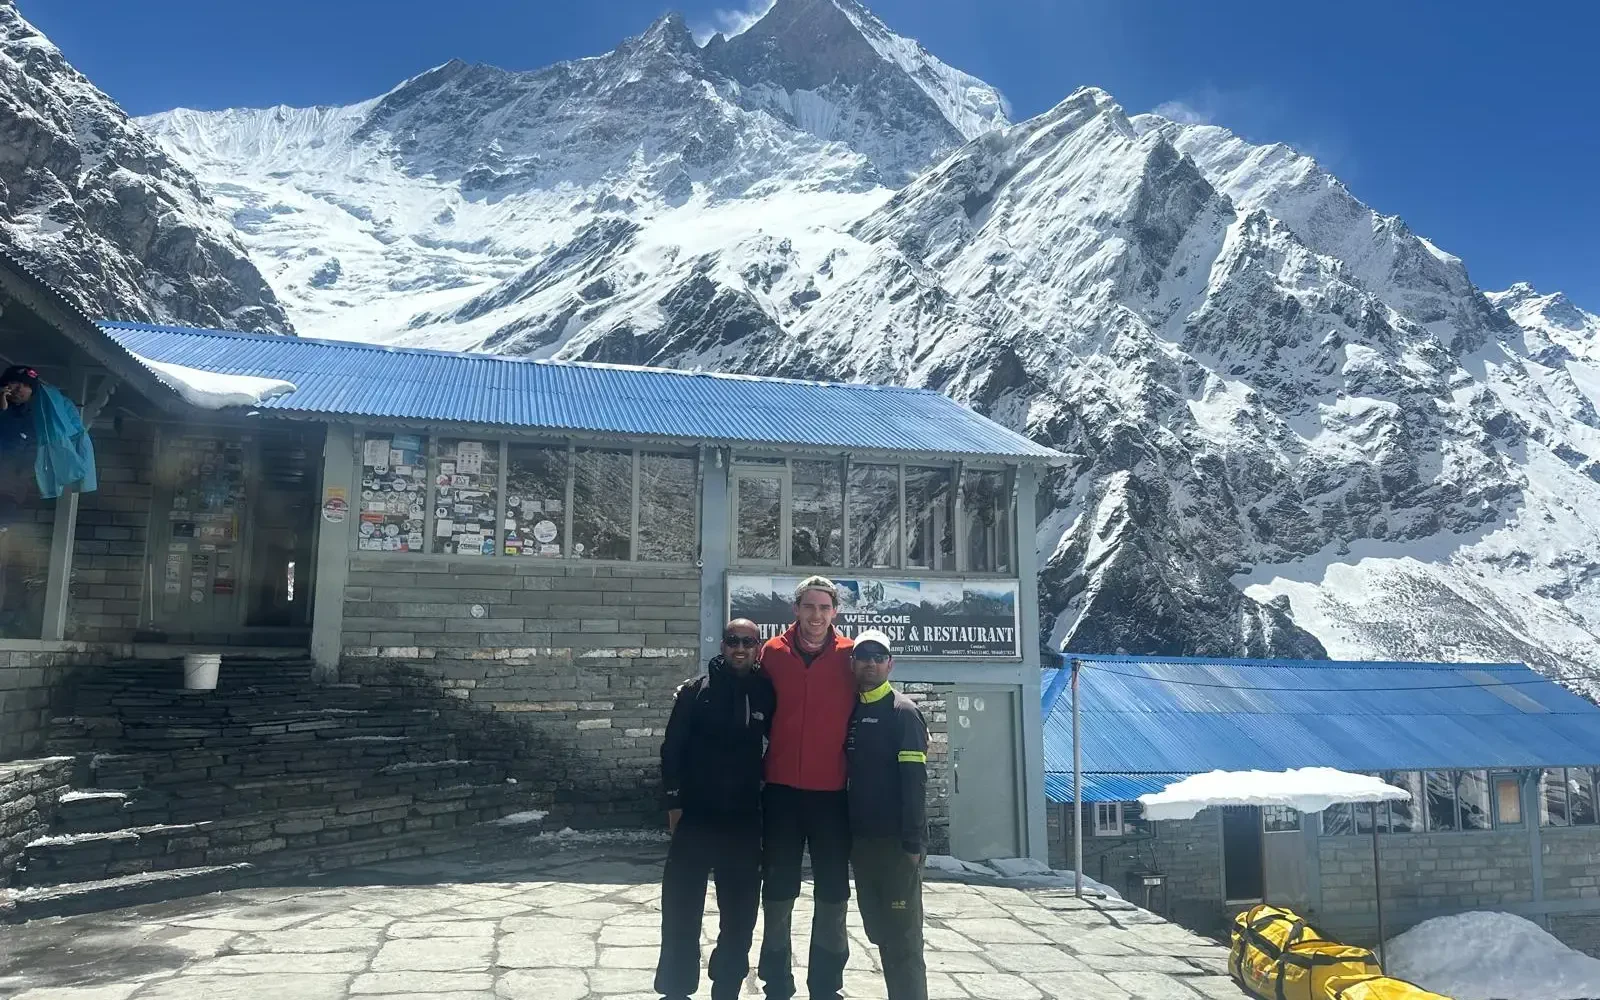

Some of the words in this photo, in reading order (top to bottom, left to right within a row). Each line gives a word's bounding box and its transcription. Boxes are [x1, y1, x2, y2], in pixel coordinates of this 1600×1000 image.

[844, 614, 911, 624] WELCOME
[909, 625, 920, 641] &
[923, 626, 1014, 643] RESTAURANT
[890, 646, 904, 654] amp
